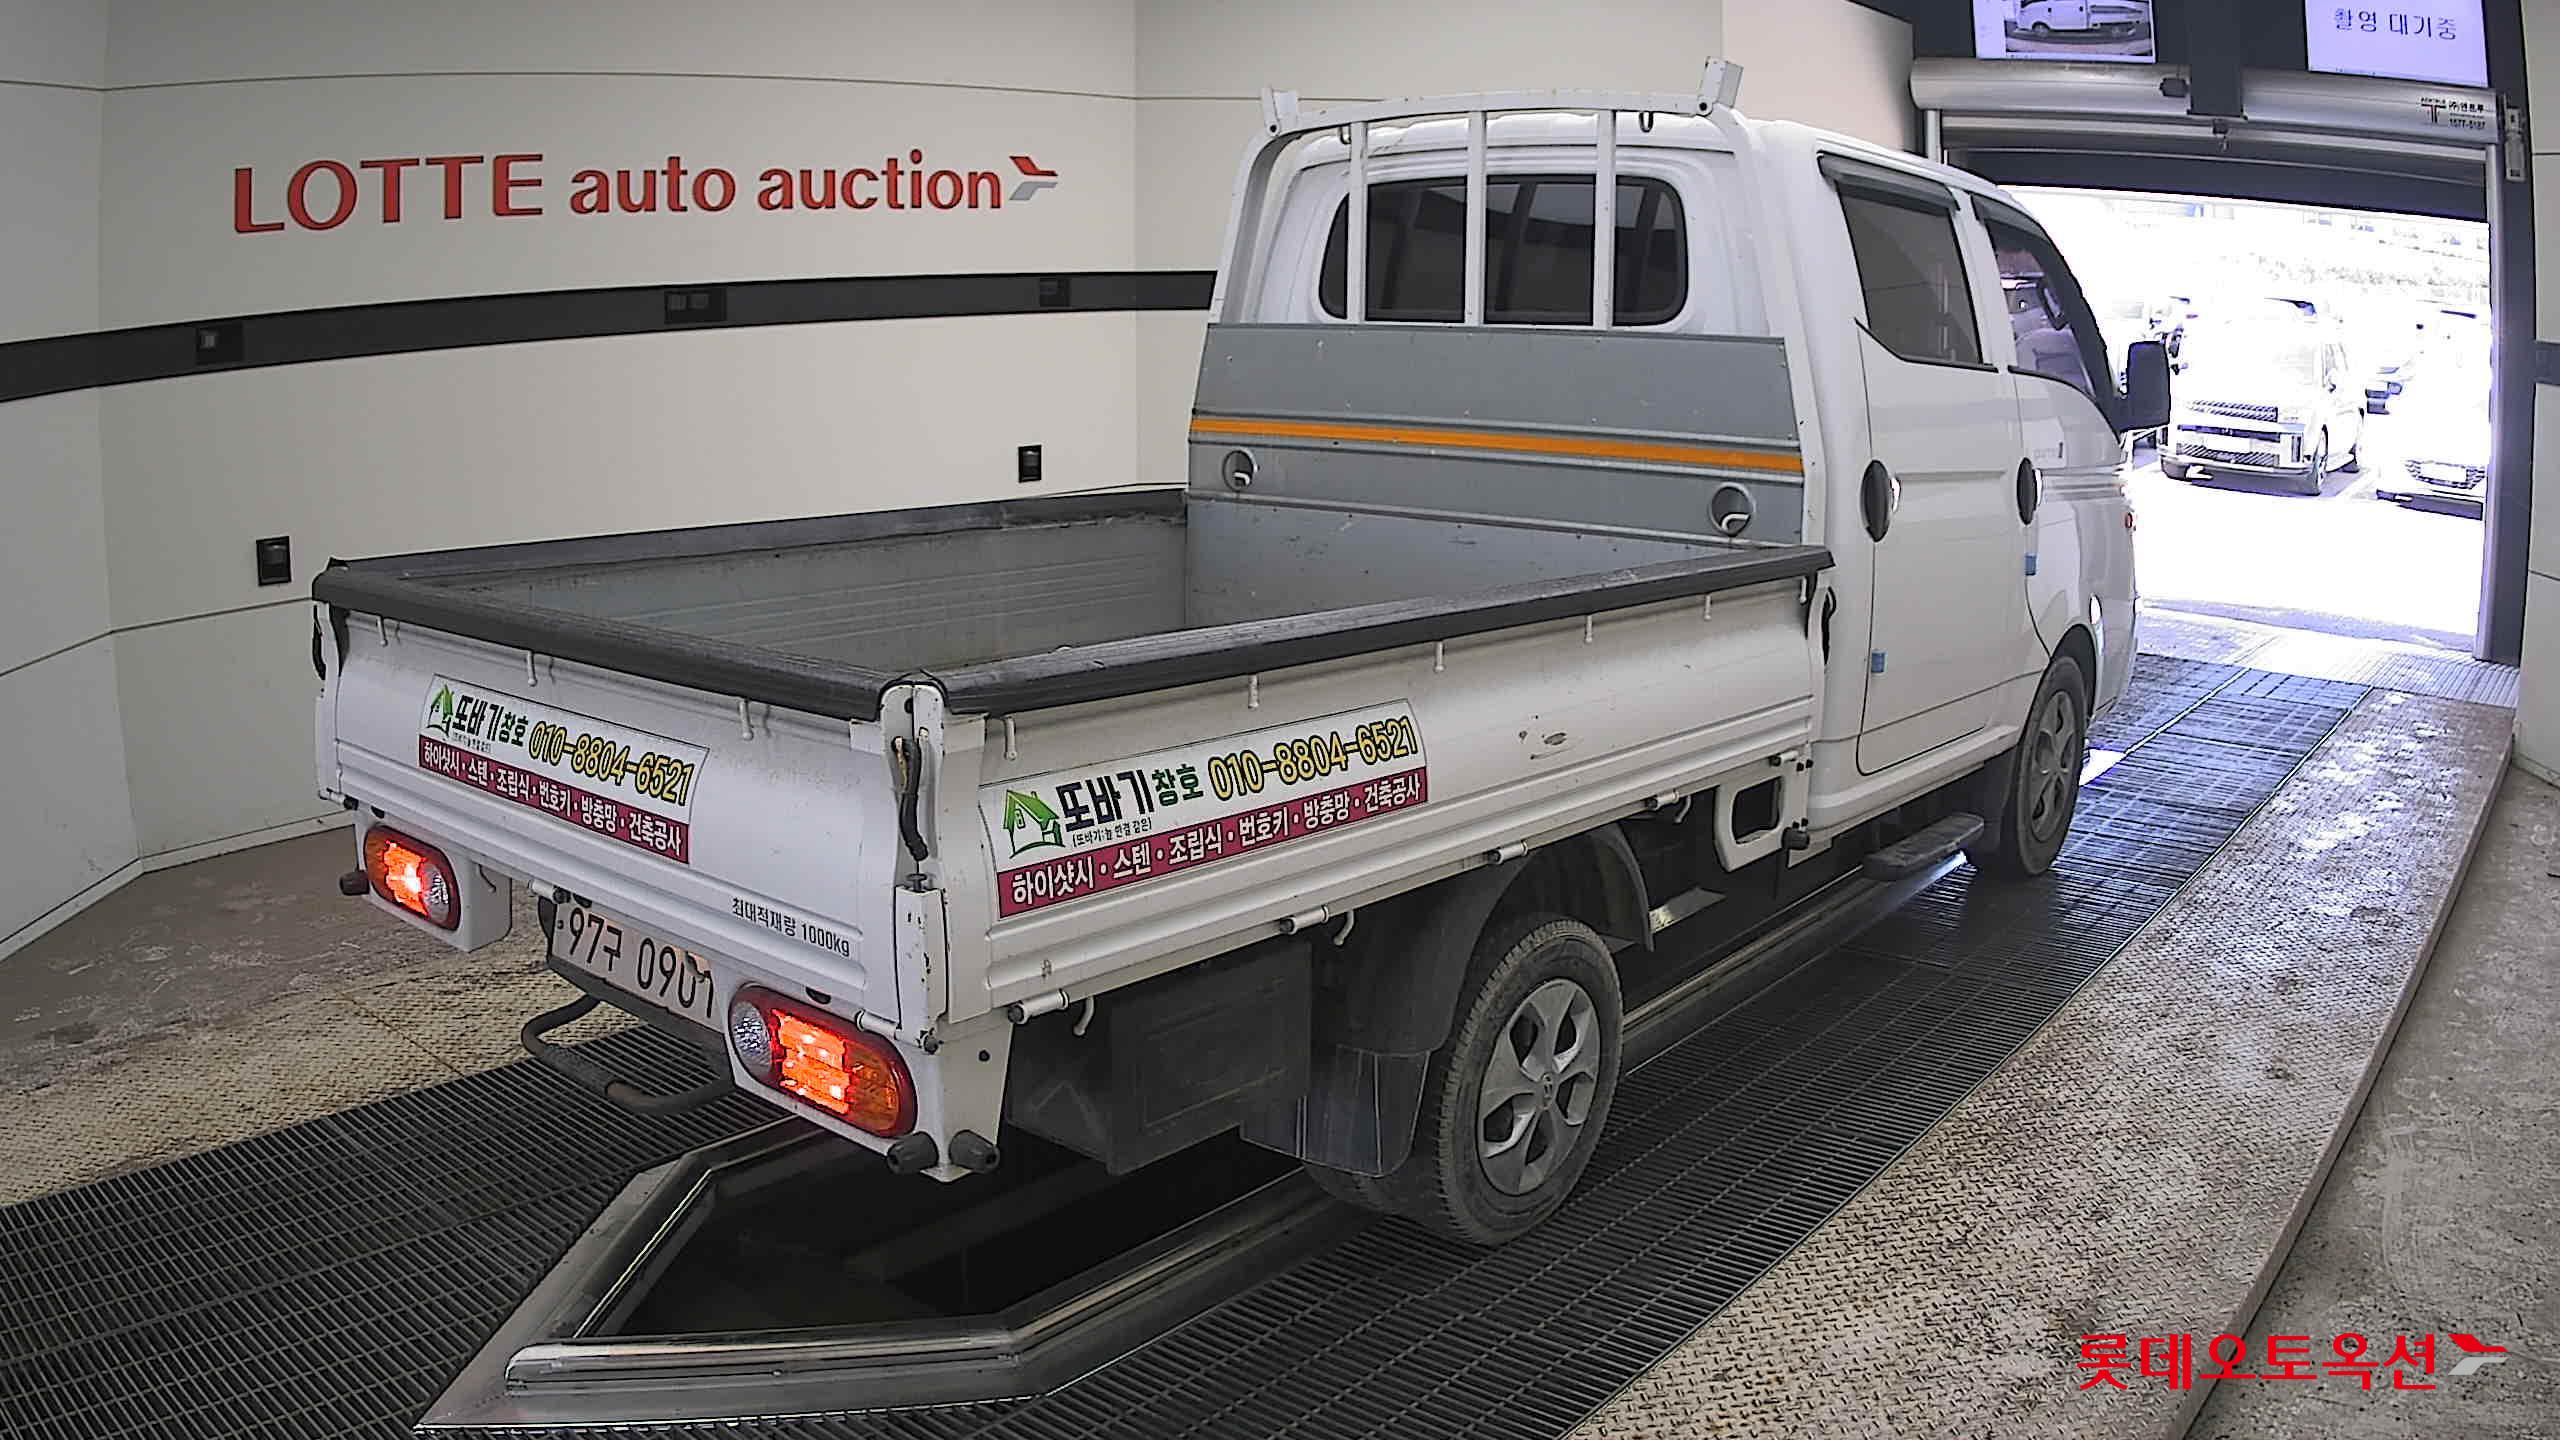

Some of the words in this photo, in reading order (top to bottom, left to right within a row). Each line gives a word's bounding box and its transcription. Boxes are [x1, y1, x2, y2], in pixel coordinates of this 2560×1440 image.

[2389, 13, 2457, 40] 대기중
[234, 153, 543, 233] LOTTE
[570, 156, 735, 214] auto
[757, 149, 1002, 211] auction
[529, 721, 694, 806] 010-8804-6521
[1208, 716, 1419, 800] 010-8804-6521
[496, 768, 530, 801] 조립식
[581, 795, 618, 833] 방충망
[629, 812, 681, 856] 건축공사
[1169, 823, 1222, 865] 조립식
[1303, 791, 1350, 829] 방충망
[1364, 773, 1421, 812] 건축공사
[569, 907, 623, 972] 97구
[731, 897, 797, 937] 최대적재량
[801, 922, 850, 958] 1000kg
